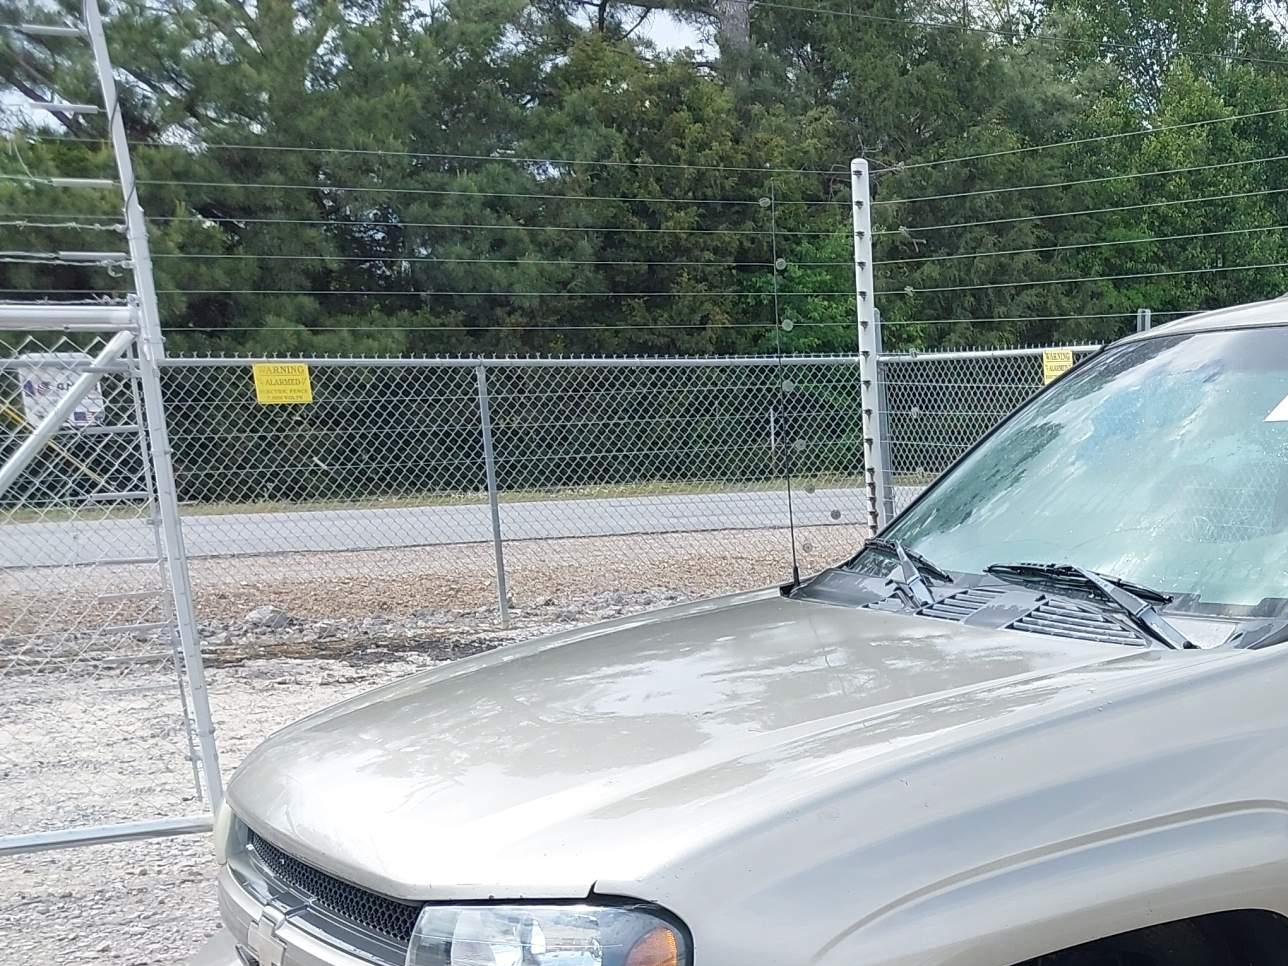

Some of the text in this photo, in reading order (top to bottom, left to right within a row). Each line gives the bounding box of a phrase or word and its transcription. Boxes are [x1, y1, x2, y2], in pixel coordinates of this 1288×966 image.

[1045, 351, 1071, 360] WARNING
[258, 365, 305, 375] WARNING
[265, 378, 301, 386] ALARMED
